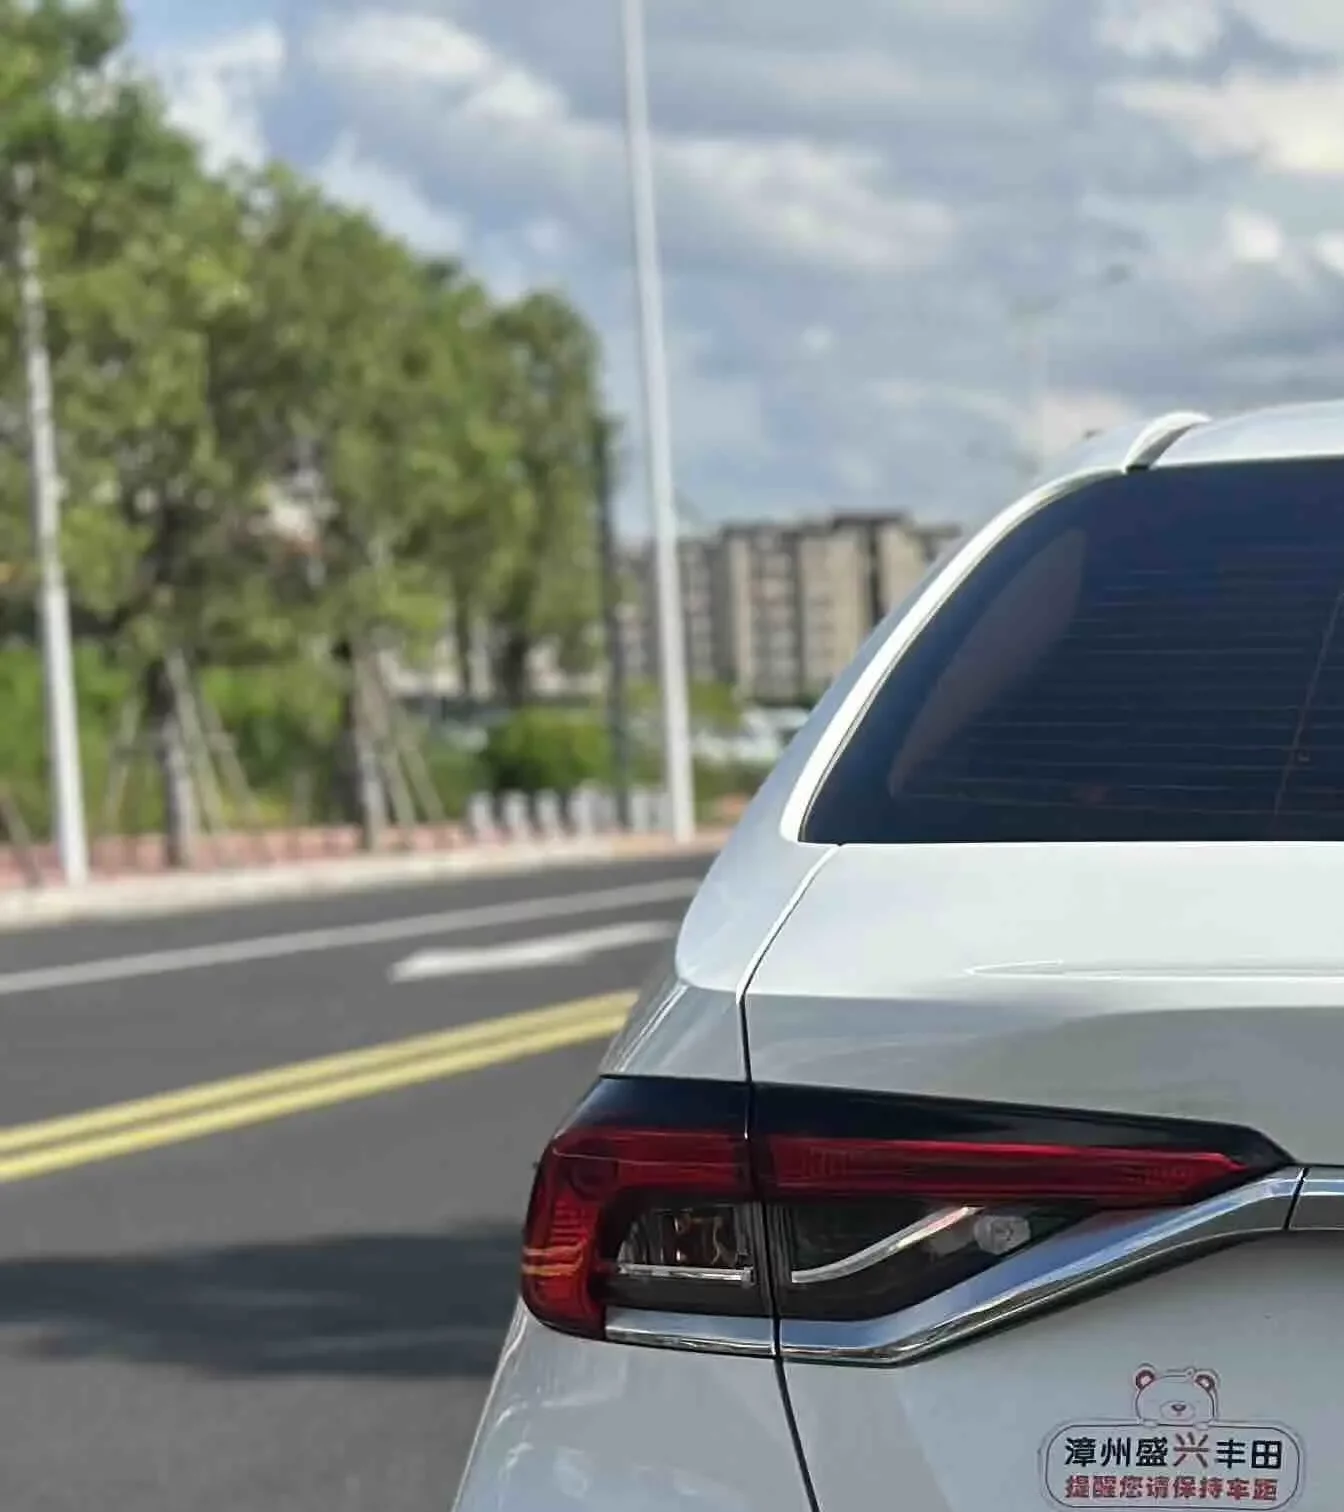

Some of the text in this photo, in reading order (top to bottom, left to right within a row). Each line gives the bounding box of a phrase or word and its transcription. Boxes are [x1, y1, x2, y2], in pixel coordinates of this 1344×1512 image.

[1063, 1431, 1283, 1470] 漳州盛兴丰田
[1064, 1474, 1280, 1502] 提醒您请保持车距
